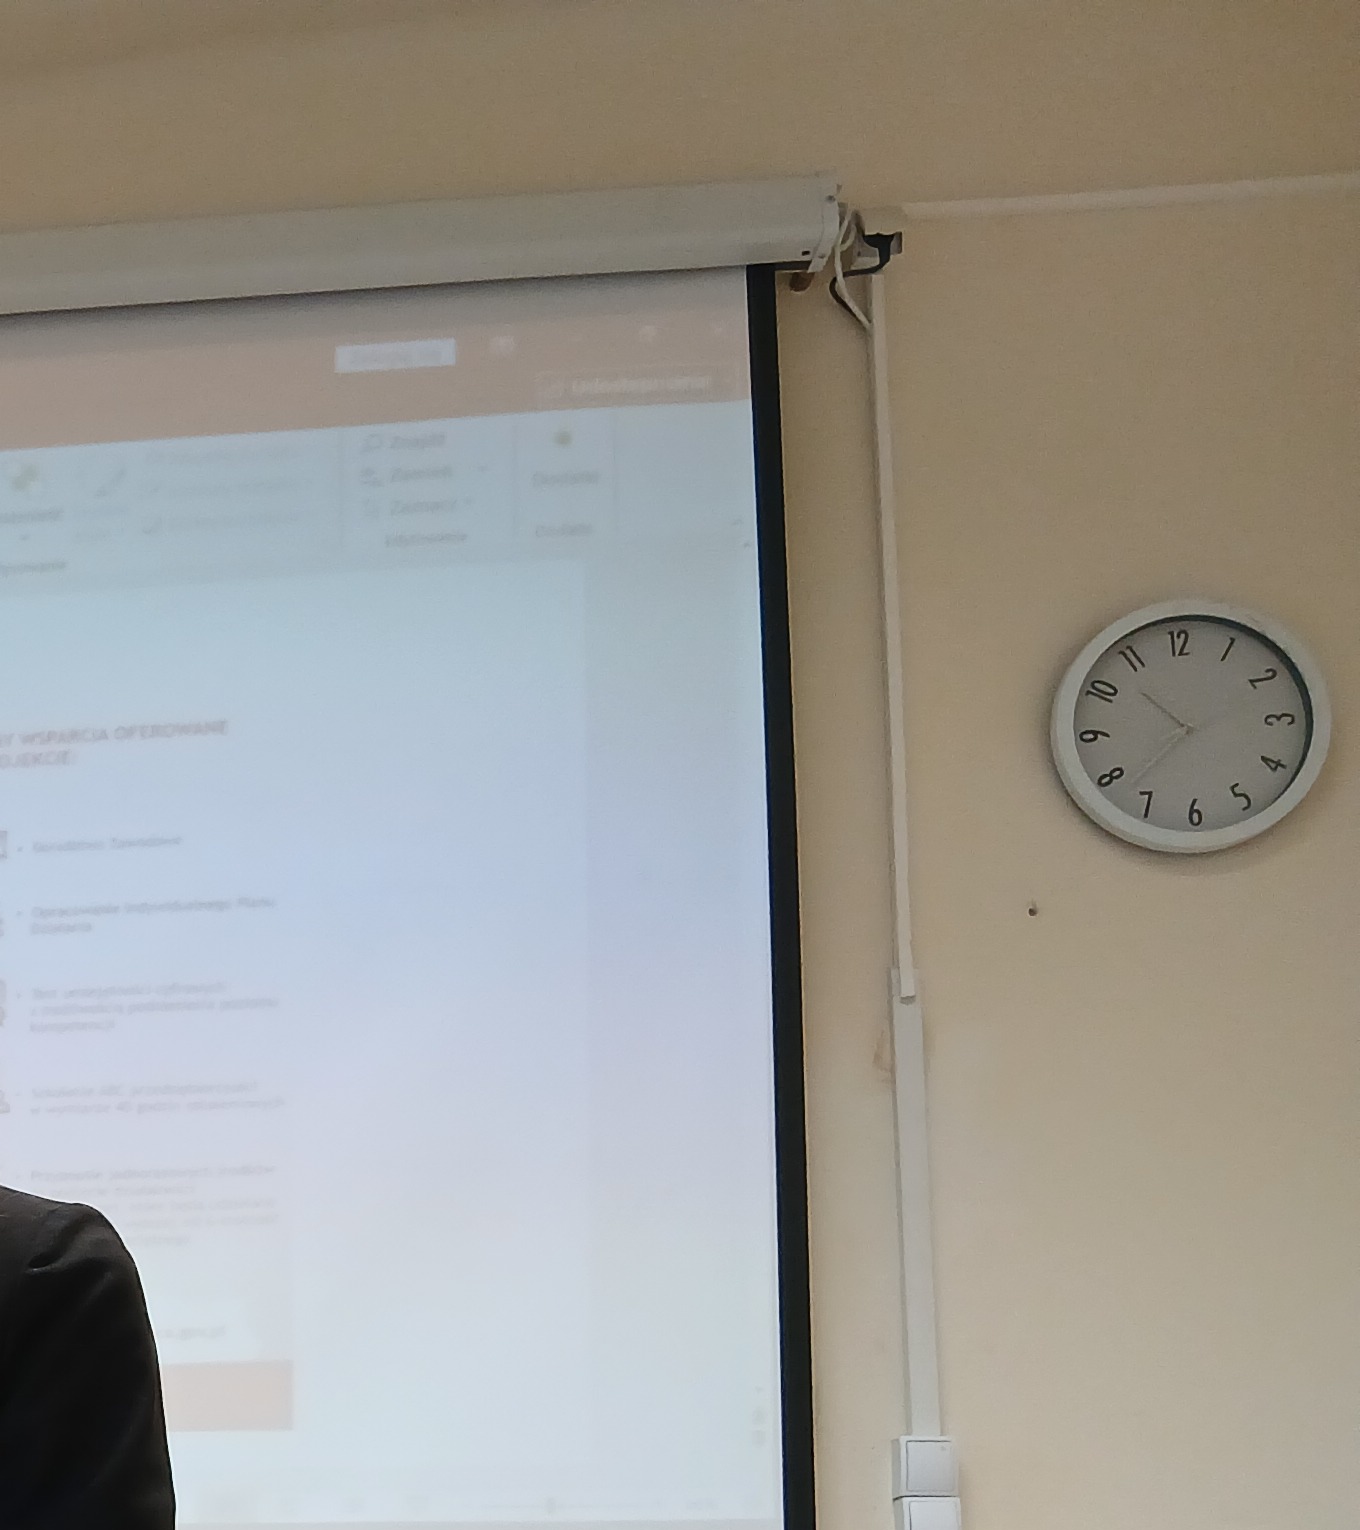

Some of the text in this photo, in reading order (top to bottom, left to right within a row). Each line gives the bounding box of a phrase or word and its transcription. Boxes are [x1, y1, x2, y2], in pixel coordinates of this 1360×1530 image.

[1167, 629, 1190, 657] 12
[1219, 636, 1236, 662] 1
[1117, 645, 1146, 673] 11
[1248, 667, 1278, 690] 2
[1085, 679, 1119, 704] 10
[1264, 712, 1295, 727] 3
[1079, 728, 1111, 744] 9
[1260, 754, 1287, 772] 4
[1096, 766, 1125, 788] 8
[1139, 790, 1154, 819] 7
[1229, 782, 1252, 811] 5
[1188, 798, 1203, 826] 6
